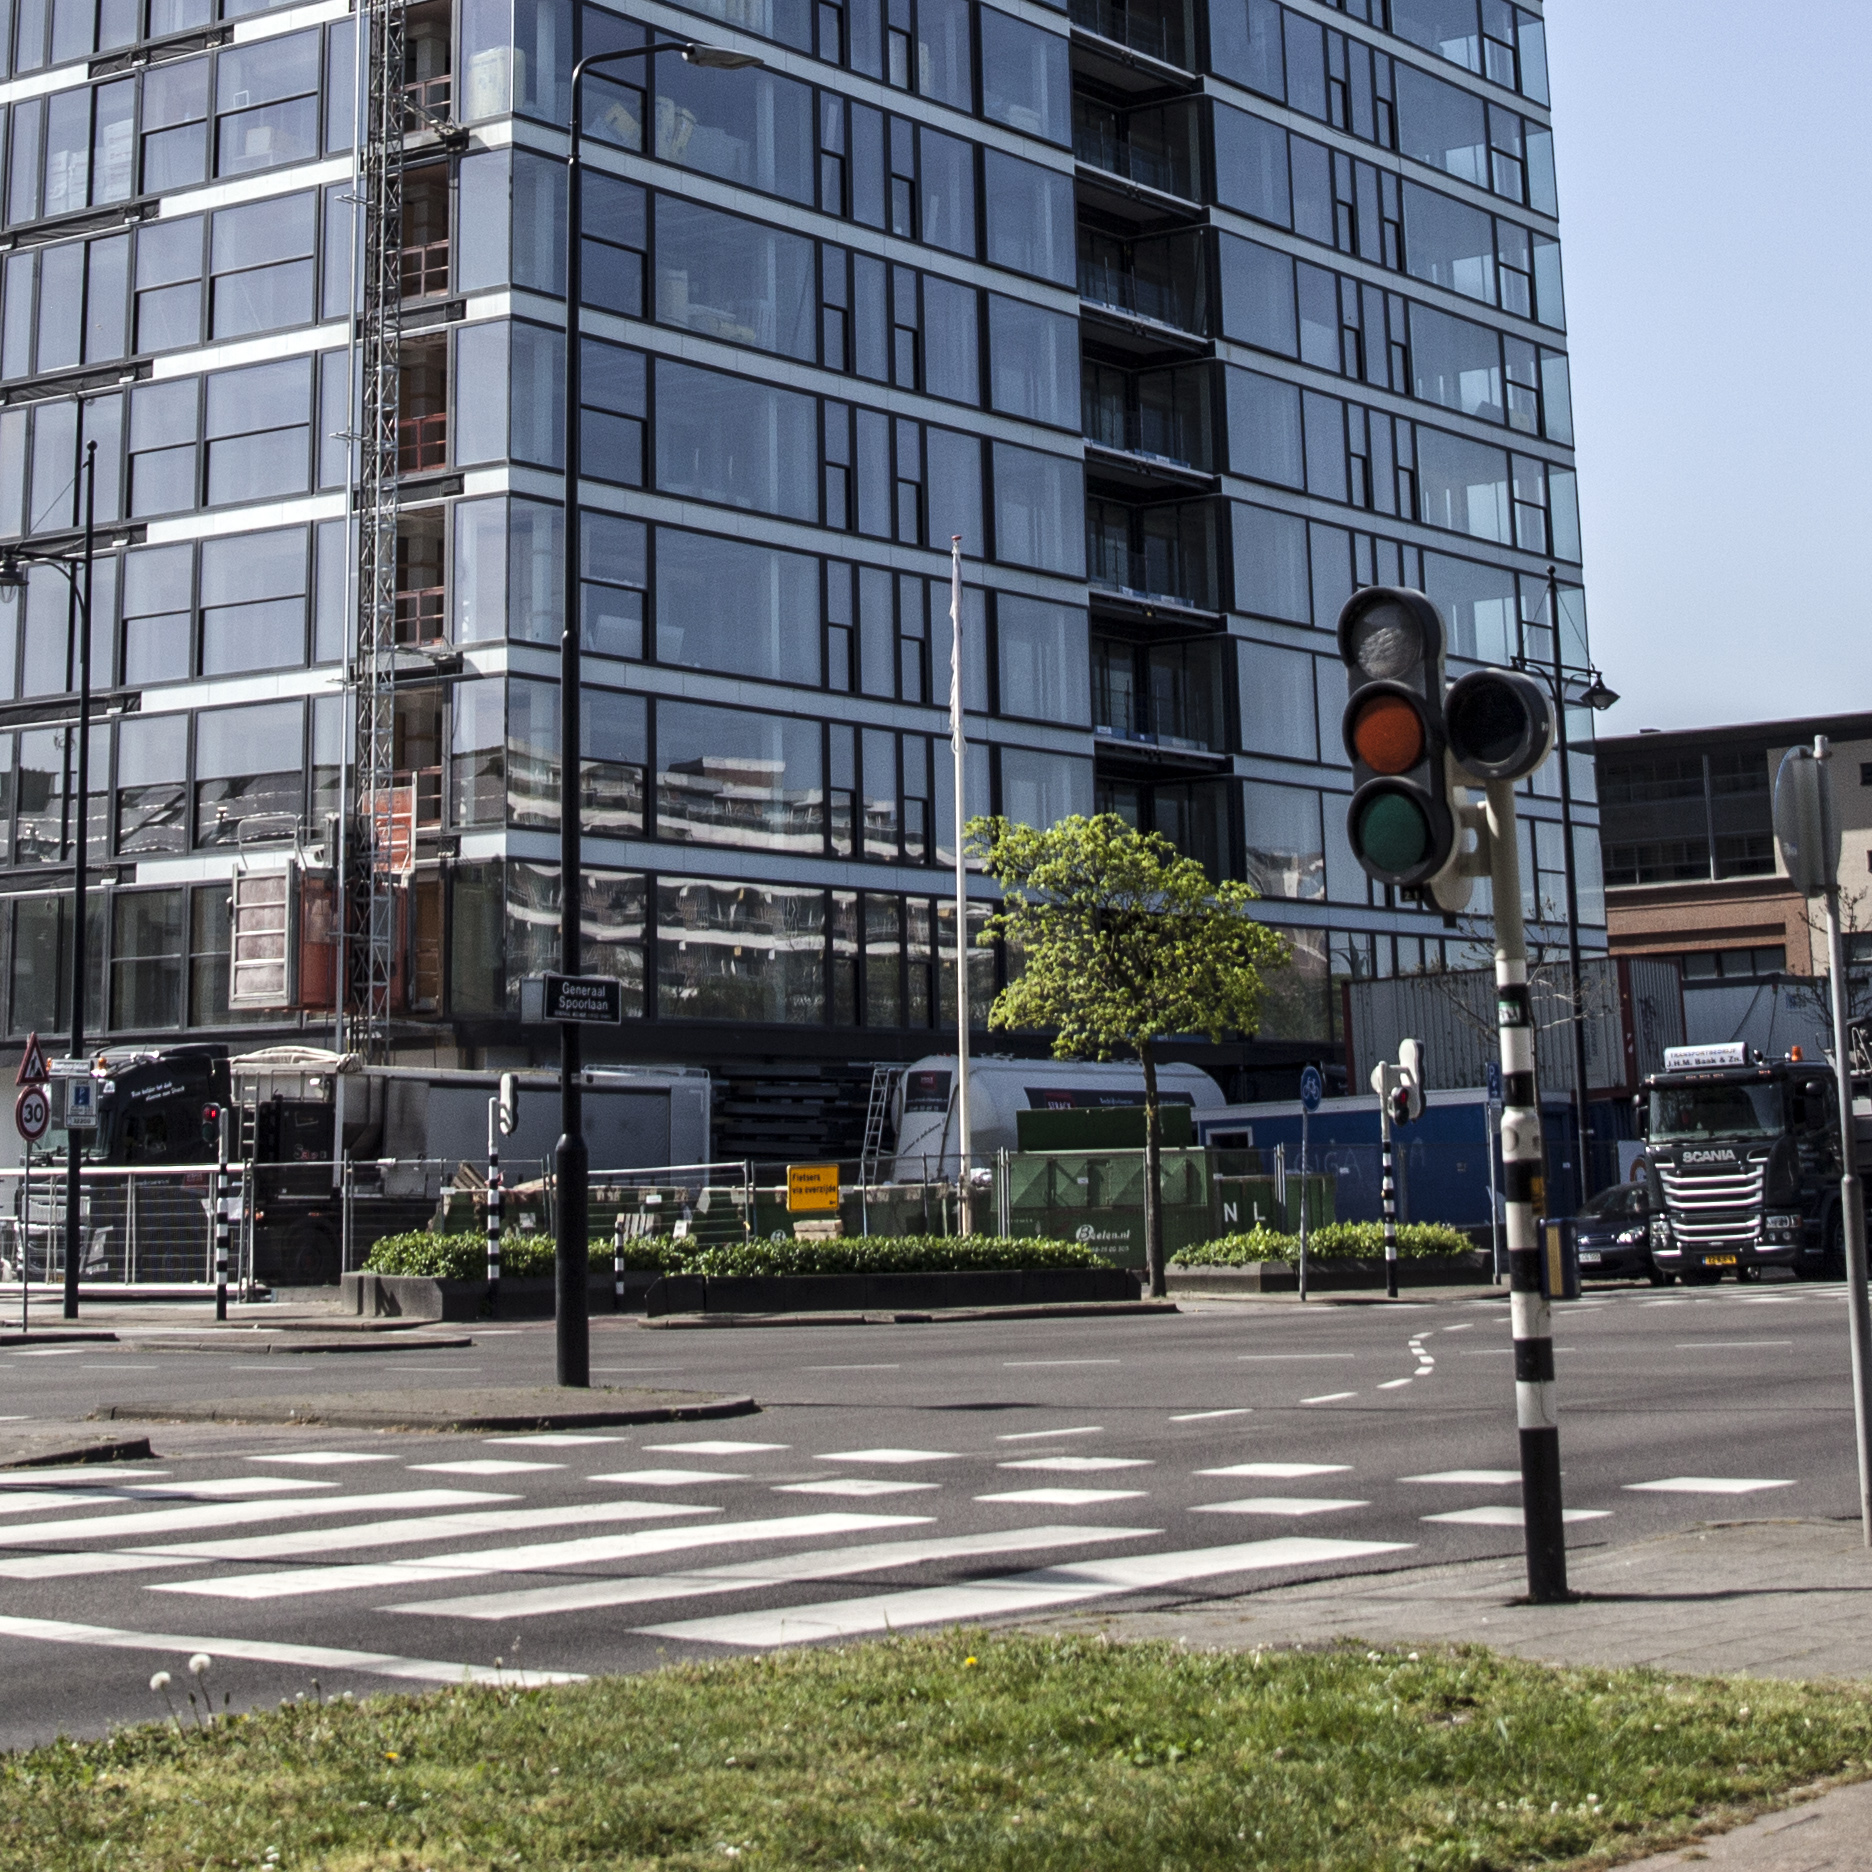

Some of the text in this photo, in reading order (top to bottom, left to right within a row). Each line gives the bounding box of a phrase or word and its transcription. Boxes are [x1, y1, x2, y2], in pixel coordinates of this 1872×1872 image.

[562, 981, 606, 997] Generaal
[559, 995, 608, 1010] Spoorlaan
[23, 1103, 44, 1124] 30
[1682, 1148, 1737, 1164] SCANIA
[792, 1172, 821, 1182] Fietsers
[792, 1184, 836, 1196] via overzijde
[1223, 1200, 1238, 1222] N
